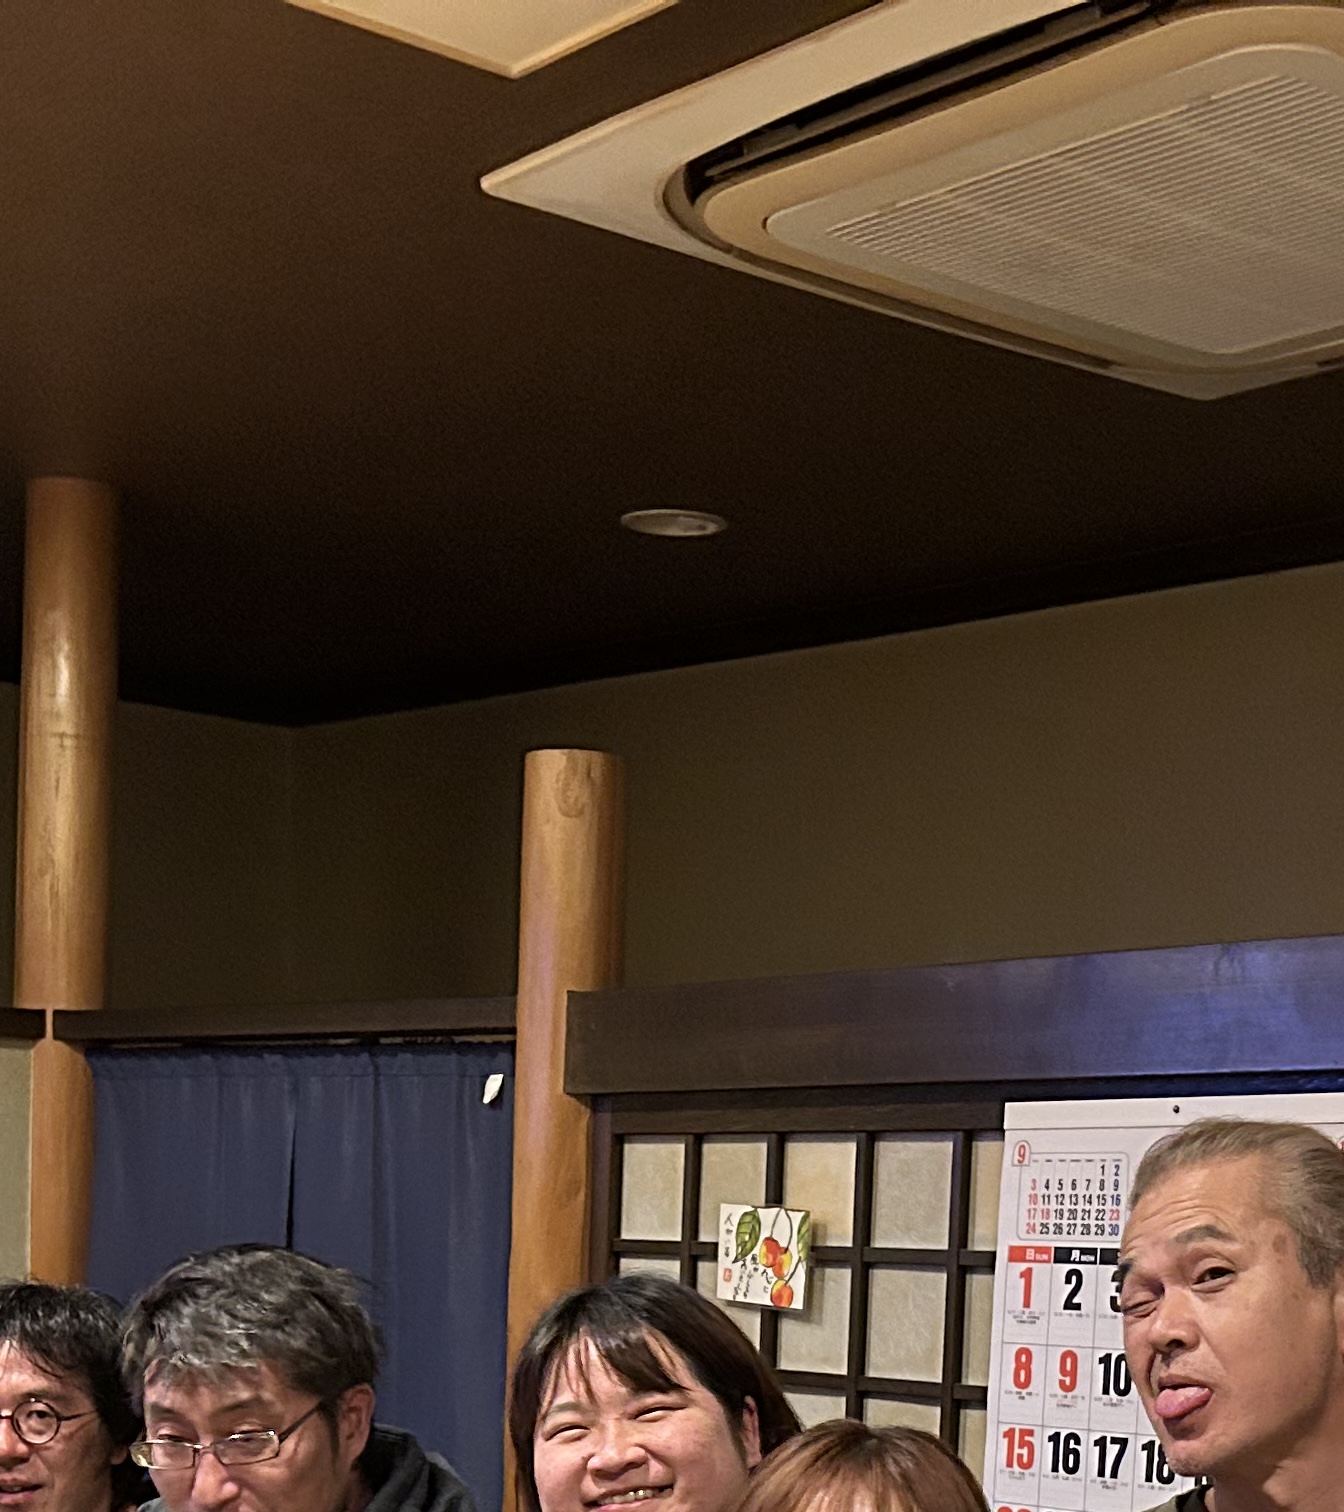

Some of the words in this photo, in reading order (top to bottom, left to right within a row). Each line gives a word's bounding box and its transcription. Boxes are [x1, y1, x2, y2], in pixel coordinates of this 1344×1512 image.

[1017, 1144, 1026, 1164] 9
[1100, 1164, 1105, 1176] 1
[1114, 1164, 1120, 1176] 2
[1044, 1179, 1050, 1191] 4
[1057, 1179, 1063, 1191] 5
[1071, 1179, 1077, 1191] 6
[1085, 1179, 1091, 1191] 7
[1099, 1179, 1105, 1191] 8
[1113, 1179, 1119, 1191] 9
[1041, 1193, 1051, 1206] 11
[1054, 1193, 1065, 1206] 12
[1069, 1193, 1078, 1206] 13
[1082, 1193, 1093, 1206] 14
[1097, 1193, 1107, 1206] 15
[1110, 1193, 1121, 1206] 16
[1027, 1208, 1037, 1221] 17
[1041, 1208, 1050, 1221] 18
[1054, 1208, 1064, 1221] 19
[1067, 1208, 1078, 1221] 20
[1081, 1208, 1091, 1221] 21
[1095, 1208, 1106, 1221] 22
[1109, 1208, 1120, 1221] 23
[1026, 1222, 1036, 1236] 24
[1039, 1222, 1050, 1236] 25
[1053, 1222, 1063, 1236] 26
[1067, 1222, 1077, 1236] 27
[1080, 1222, 1091, 1236] 28
[1094, 1222, 1105, 1236] 29
[1108, 1222, 1120, 1236] 30
[1026, 1249, 1034, 1260] 日
[1071, 1250, 1080, 1261] 月
[1019, 1267, 1033, 1308] 1
[1063, 1268, 1083, 1311] 2
[1013, 1347, 1033, 1389] 8
[1059, 1350, 1078, 1392] 9
[1098, 1353, 1132, 1397] 10
[1003, 1427, 1035, 1469] 15
[1048, 1431, 1082, 1474] 16
[1094, 1436, 1129, 1479] 17
[1141, 1440, 1176, 1484] 18
